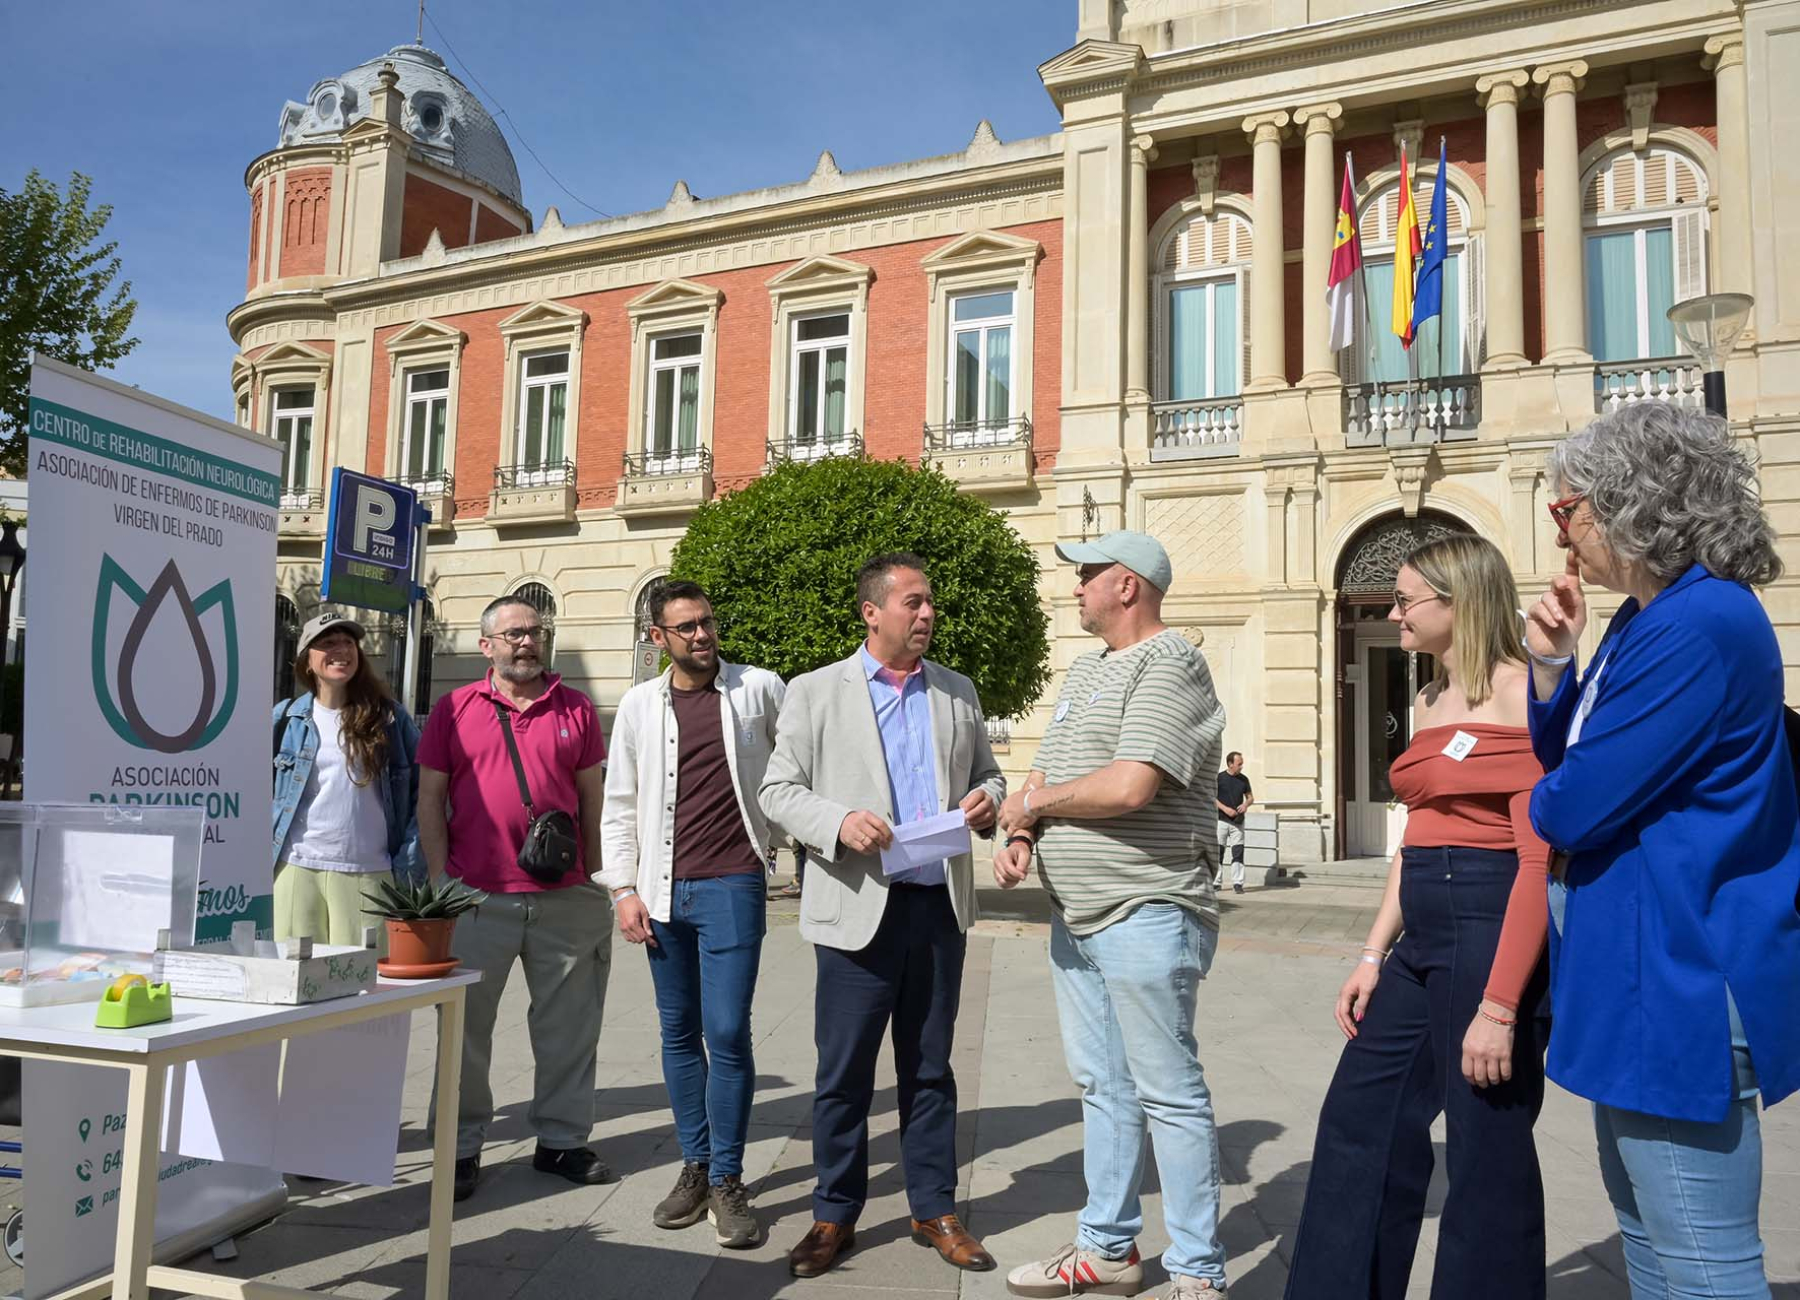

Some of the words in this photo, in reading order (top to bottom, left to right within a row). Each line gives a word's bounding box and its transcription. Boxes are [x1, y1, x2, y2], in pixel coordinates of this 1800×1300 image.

[34, 409, 90, 445] CENTRO
[109, 433, 204, 480] REHABILITACIÓN
[207, 465, 275, 500] NEUROLÓGICA
[37, 451, 118, 491] ASOCIACIÓN
[122, 474, 137, 496] DE
[141, 480, 203, 514] ENFERMOS
[205, 497, 219, 518] DE
[222, 502, 276, 534] PARKINSON
[353, 485, 396, 553] P
[114, 503, 159, 532] VIRGEN
[162, 517, 183, 538] DEL
[186, 523, 223, 547] PRADO
[372, 545, 394, 559] 24H
[111, 762, 219, 786] ASOCIACIÓN
